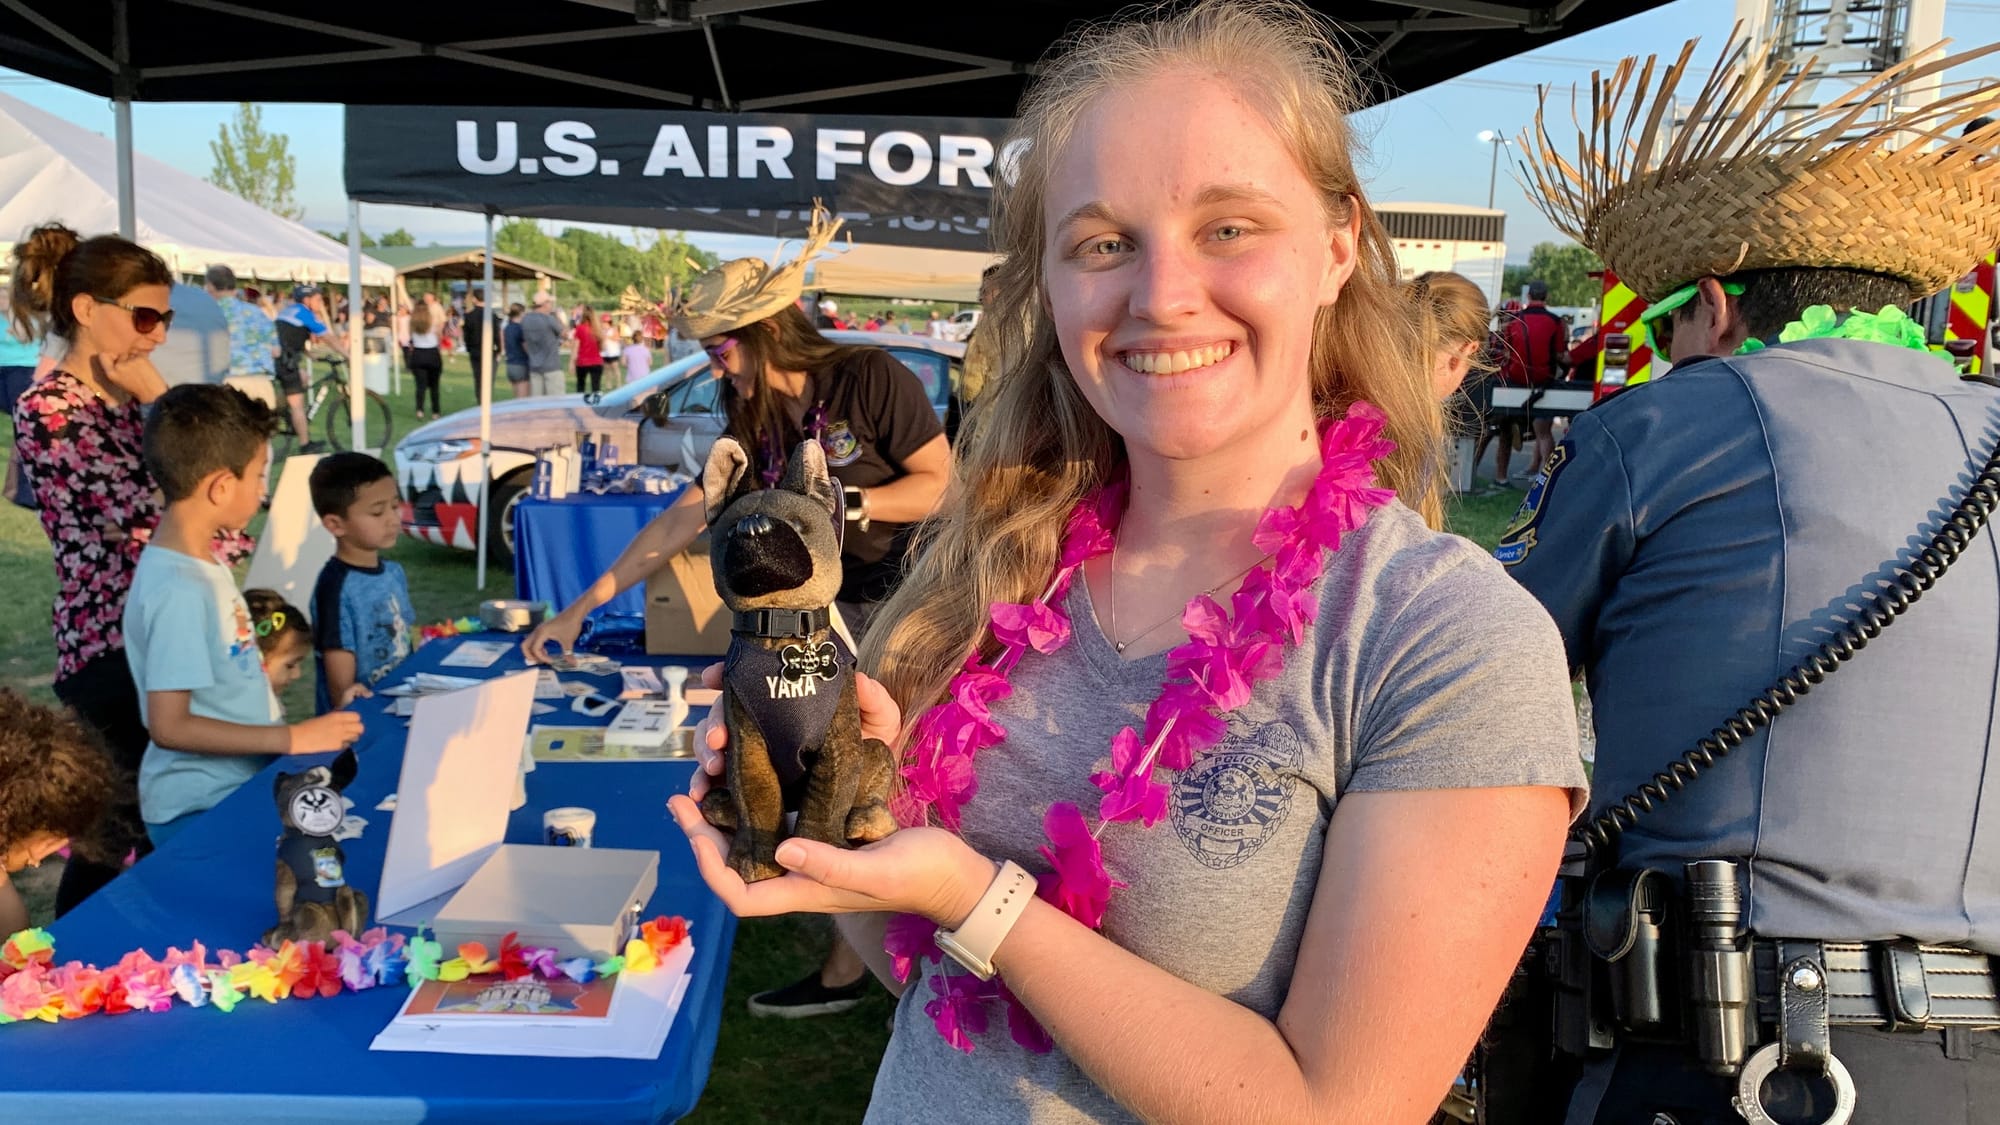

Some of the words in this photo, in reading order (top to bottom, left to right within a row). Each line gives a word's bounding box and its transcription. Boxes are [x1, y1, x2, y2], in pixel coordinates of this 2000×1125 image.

[456, 120, 620, 177] U.S.
[642, 124, 794, 179] AIR
[765, 675, 817, 699] YARA
[1214, 755, 1264, 771] POLICE
[1200, 823, 1244, 837] OFFICER
